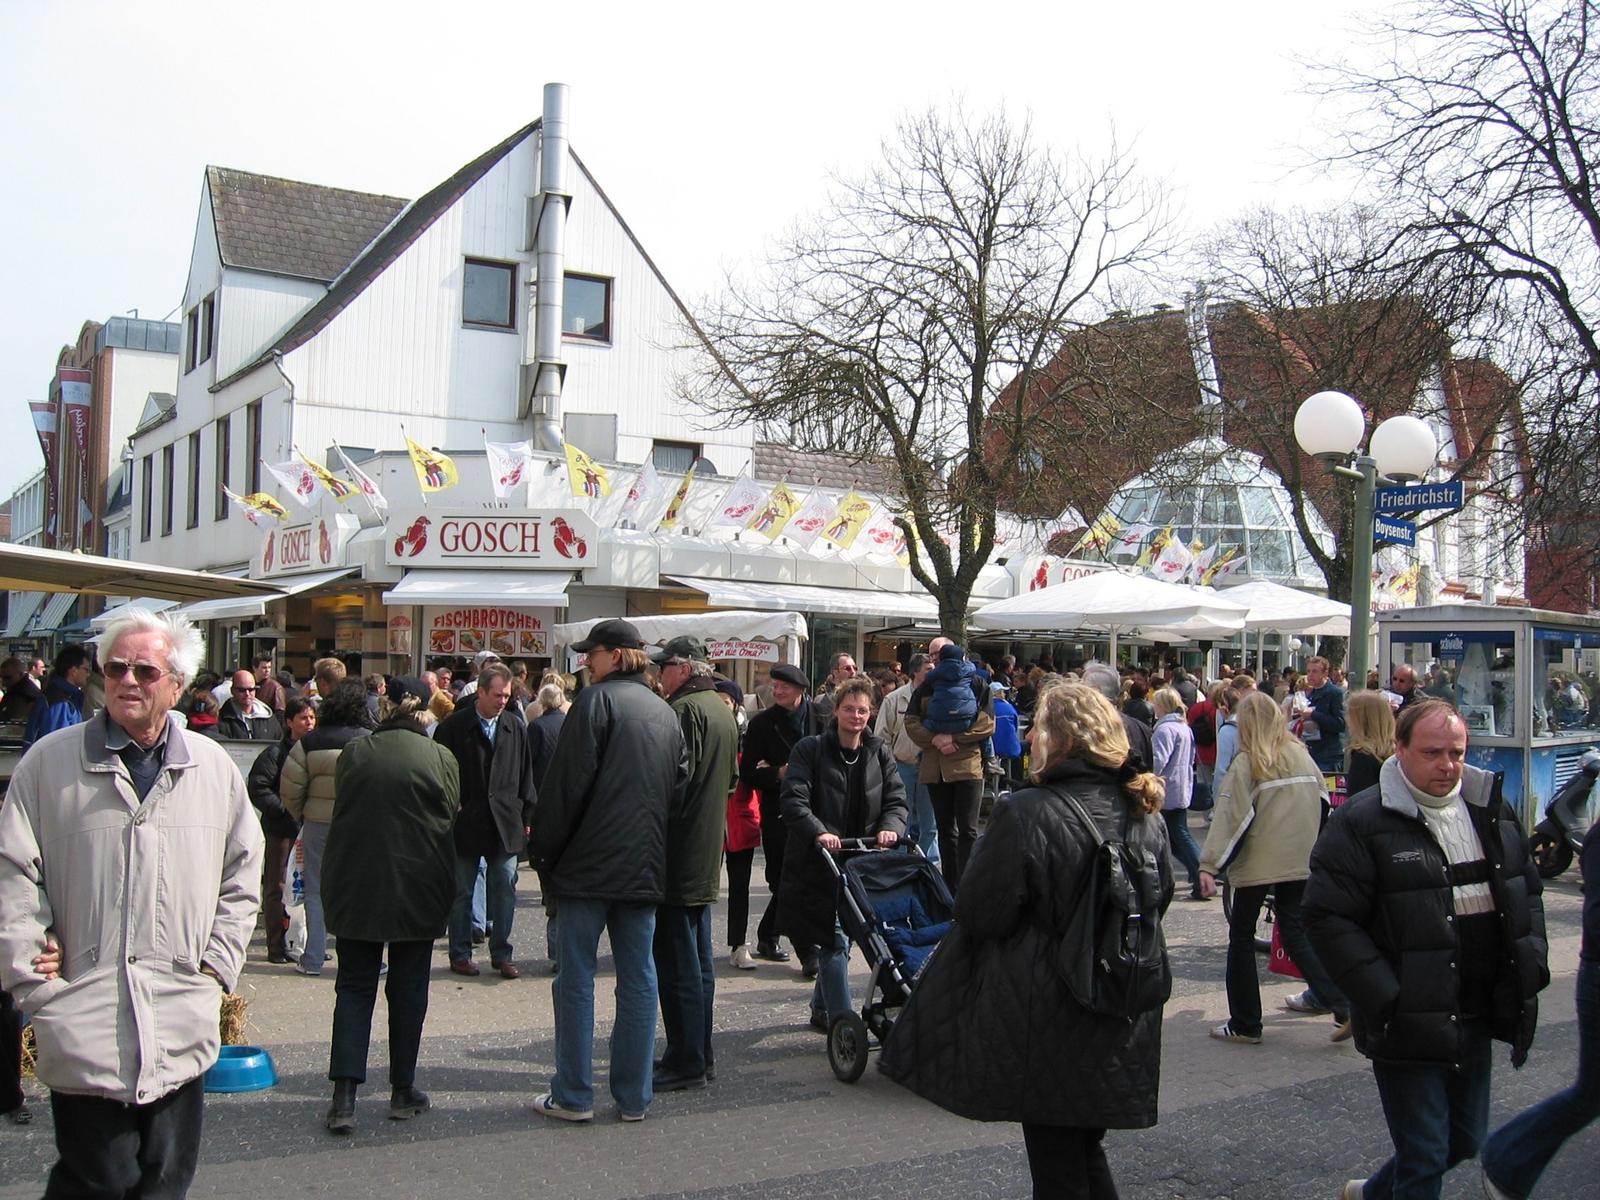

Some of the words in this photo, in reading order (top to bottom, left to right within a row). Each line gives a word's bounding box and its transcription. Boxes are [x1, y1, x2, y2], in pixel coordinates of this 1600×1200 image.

[1380, 488, 1458, 507] Friedrichstr.
[440, 522, 541, 553] GOSCH
[1375, 518, 1412, 541] Boysenstr.
[280, 529, 312, 565] GOSCH
[433, 606, 541, 630] FISCHBRÖTCHEN
